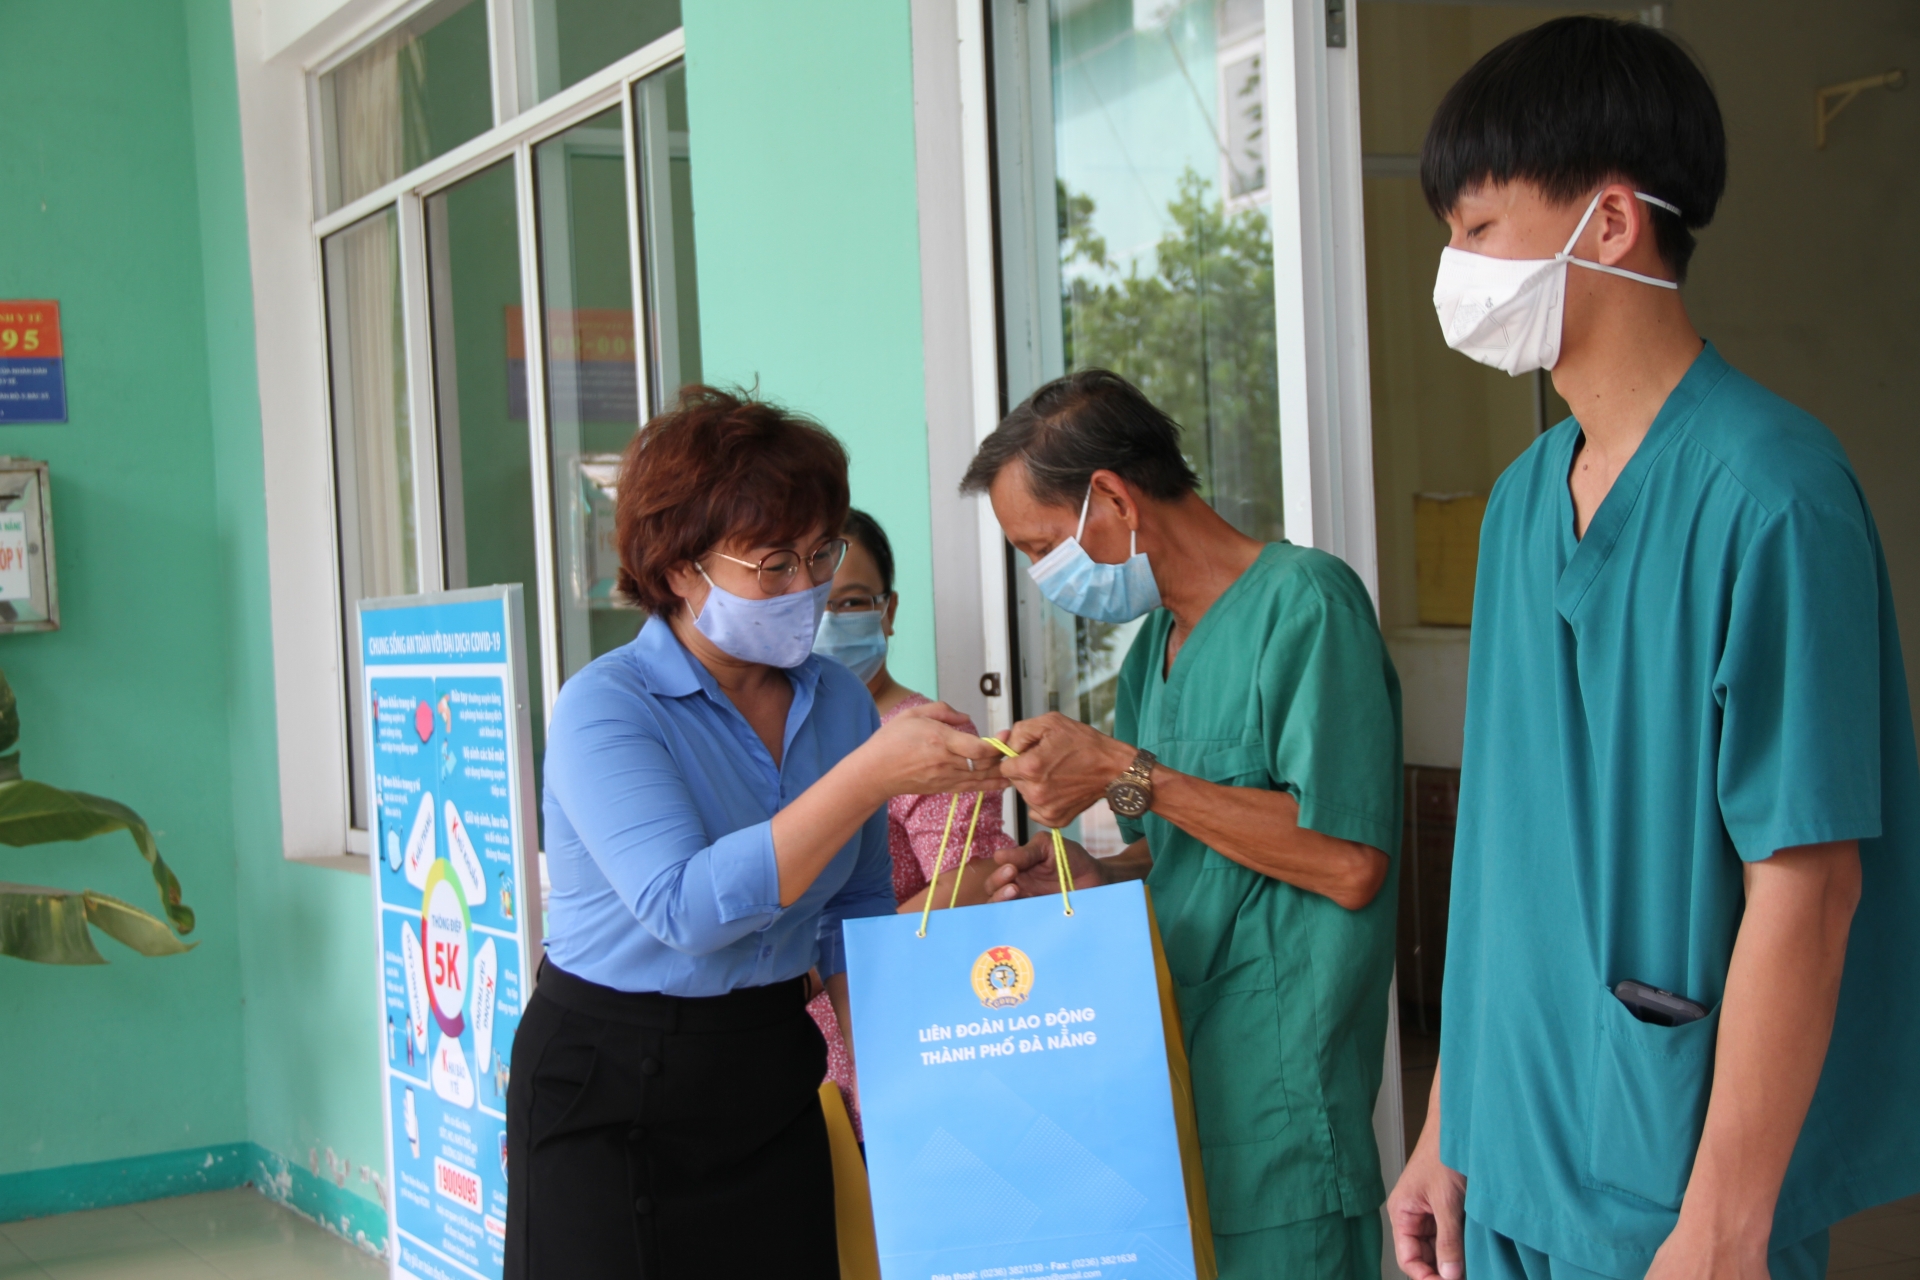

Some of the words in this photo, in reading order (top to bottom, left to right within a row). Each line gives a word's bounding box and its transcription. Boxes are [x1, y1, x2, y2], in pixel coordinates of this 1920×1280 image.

[2, 329, 39, 350] 95
[370, 636, 389, 655] CHUNG
[390, 630, 406, 655] SỐNG
[406, 635, 415, 654] AN
[415, 631, 431, 654] TOÀN
[443, 633, 453, 658] ĐẠI
[454, 633, 470, 658] DỊCH
[471, 631, 500, 652] COVID-19
[432, 913, 450, 930] THÔNG
[450, 917, 462, 936] ĐIỆP
[435, 942, 462, 991] 5K
[919, 1024, 952, 1043] LIÊN
[955, 1017, 1005, 1038] ĐOÀN
[1008, 1014, 1041, 1031] LAO
[1044, 1007, 1096, 1030] ĐỘNG
[920, 1046, 976, 1066] THÀNH
[979, 1035, 1015, 1059] PHỐ
[1019, 1035, 1044, 1054] ĐÀ
[1047, 1026, 1097, 1050] NẴNG
[438, 1164, 478, 1206] 19009095
[1050, 1261, 1070, 1270] Fax:
